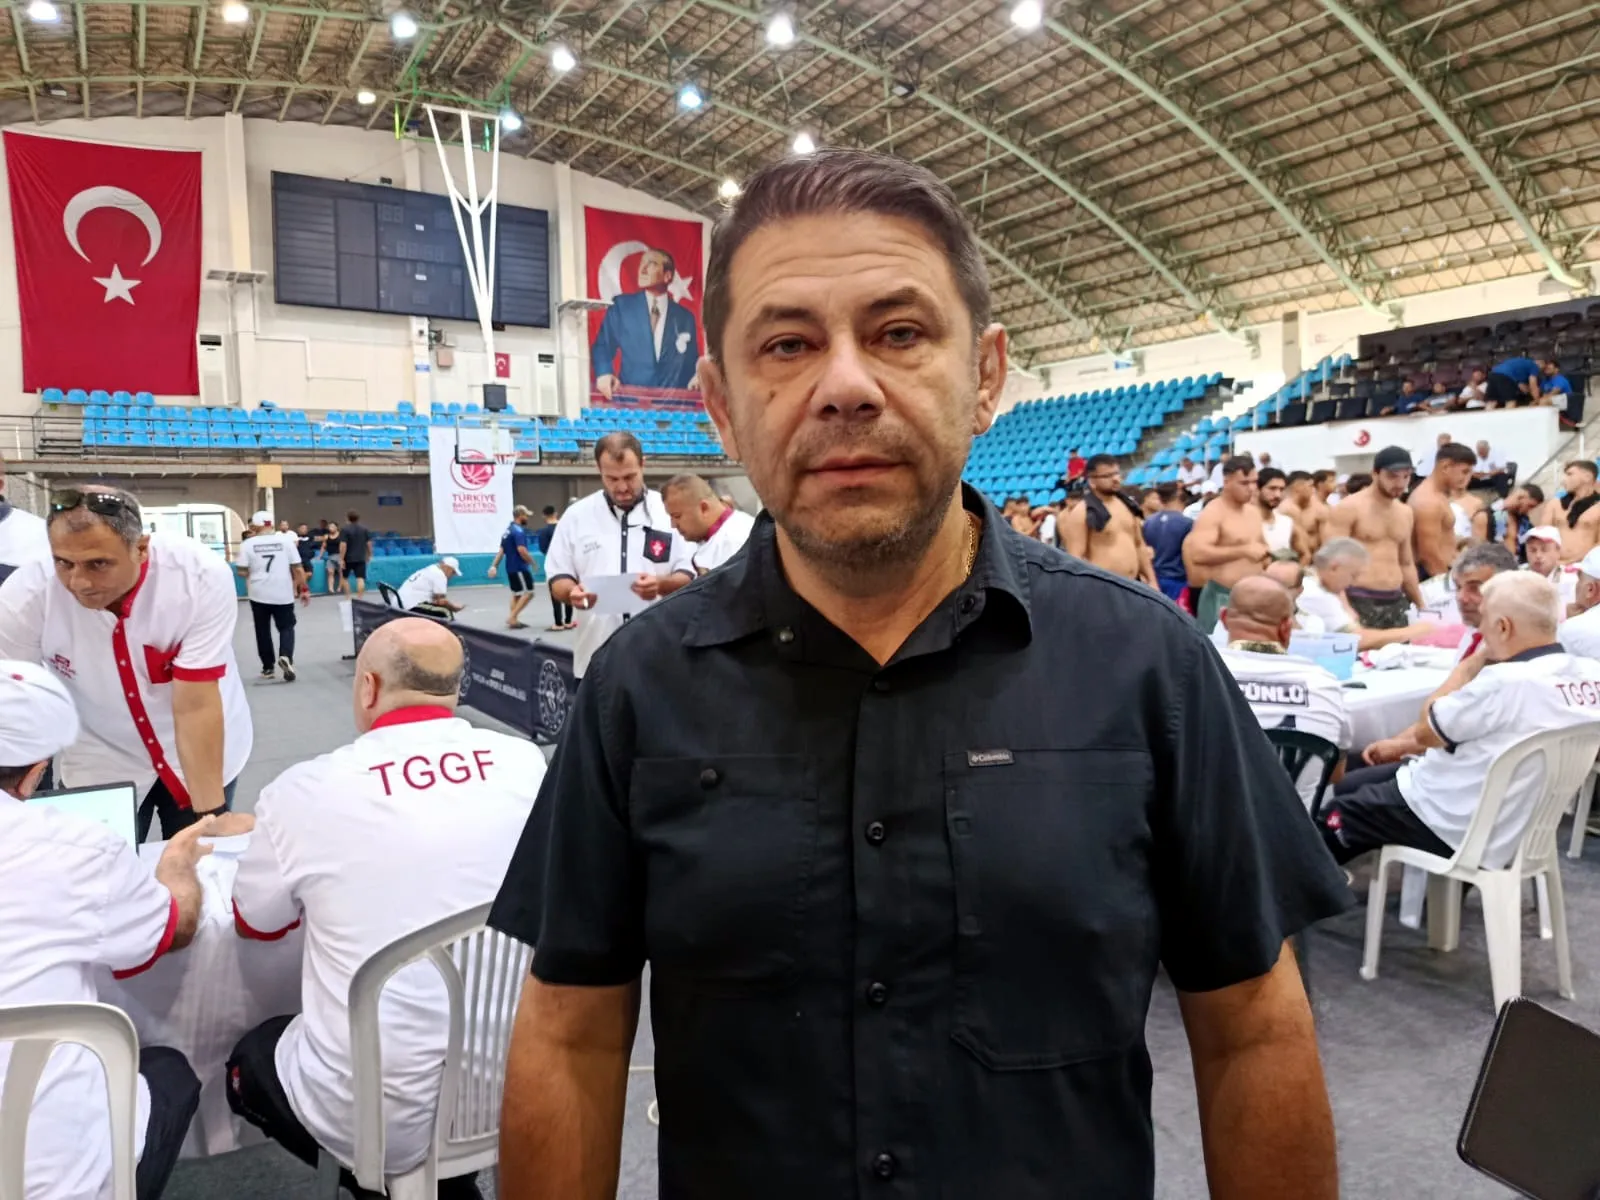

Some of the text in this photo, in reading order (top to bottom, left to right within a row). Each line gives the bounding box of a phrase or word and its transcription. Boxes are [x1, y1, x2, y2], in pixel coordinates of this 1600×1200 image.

[262, 554, 275, 573] 7
[1239, 682, 1304, 704] ÜNLÜ
[368, 749, 494, 796] TGGF
